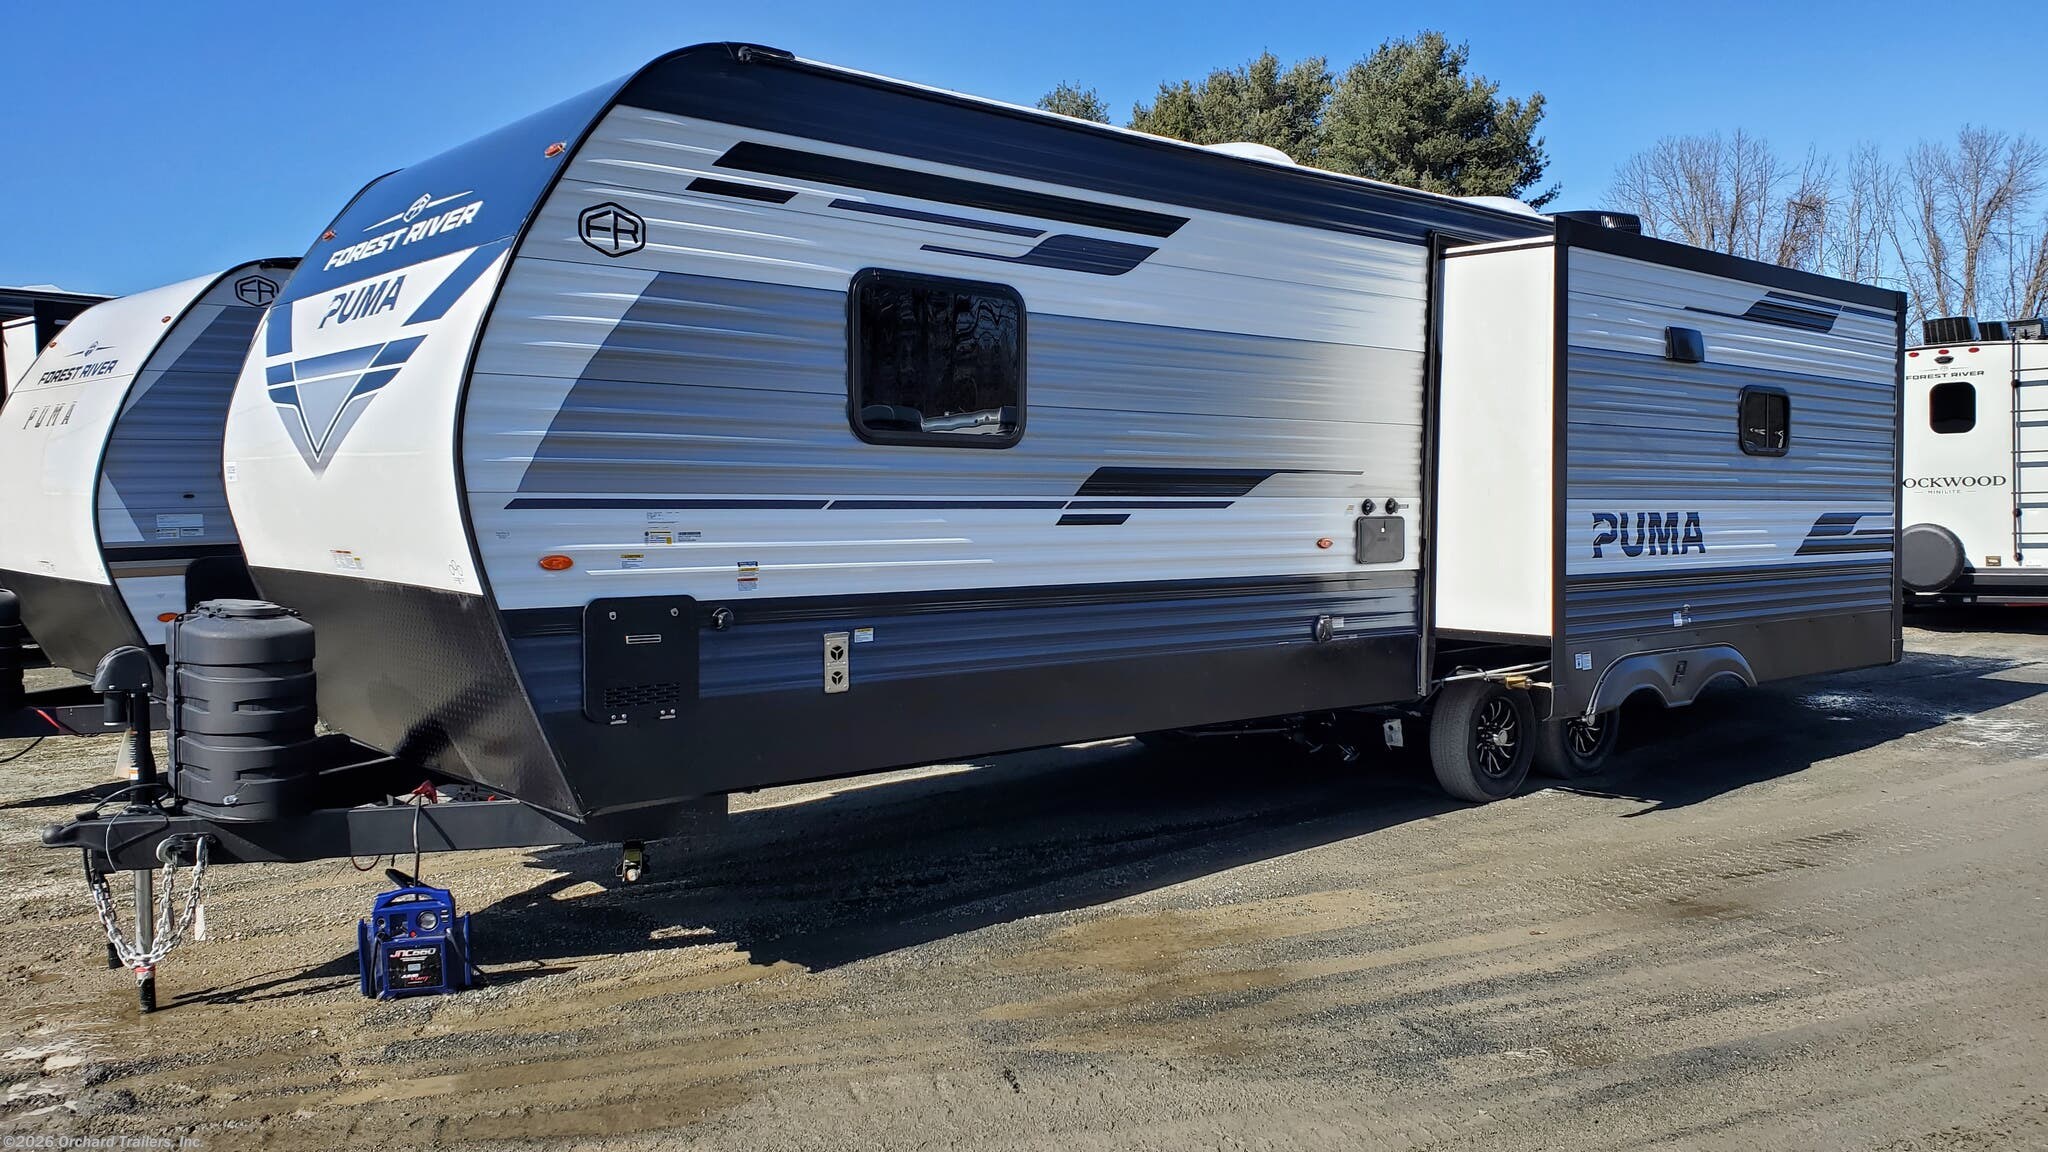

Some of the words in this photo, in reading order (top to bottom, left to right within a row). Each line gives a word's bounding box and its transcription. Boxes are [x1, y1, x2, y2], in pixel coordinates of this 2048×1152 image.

[323, 227, 409, 271] FOREST
[402, 200, 484, 246] RIVER
[317, 274, 407, 329] PUMA
[37, 365, 83, 386] FOREST
[79, 359, 119, 378] RIVER
[1905, 372, 1948, 380] FOREST
[1951, 370, 1985, 378] RIVER
[22, 400, 78, 430] PUMA
[1902, 475, 2006, 489] OCKWOOD
[1592, 511, 1706, 558] PUMA
